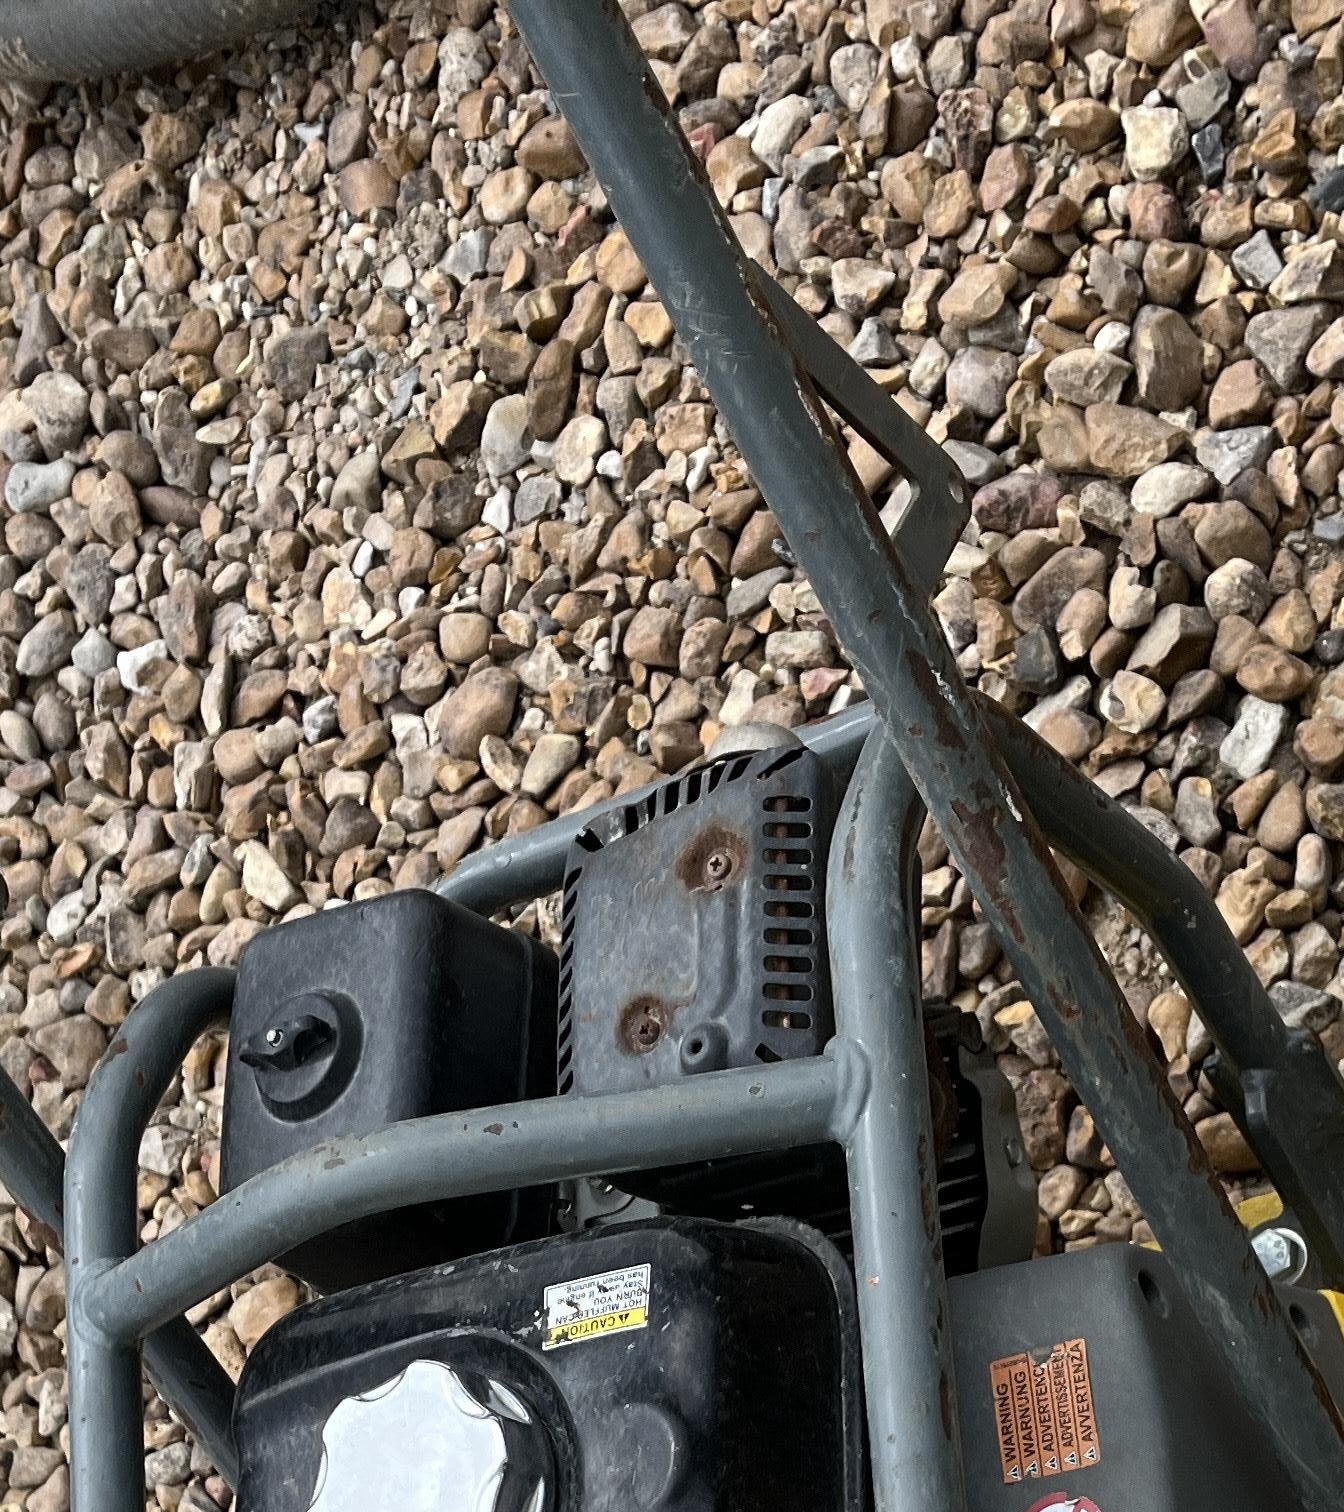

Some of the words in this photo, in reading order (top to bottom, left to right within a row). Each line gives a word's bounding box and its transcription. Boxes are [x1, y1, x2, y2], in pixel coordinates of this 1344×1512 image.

[593, 1295, 612, 1305] YOU
[623, 1280, 643, 1290] Stay
[997, 1383, 1016, 1463] WARNING
[1014, 1371, 1036, 1458] WARNUNG
[1070, 1343, 1094, 1442] AVVERTENZA
